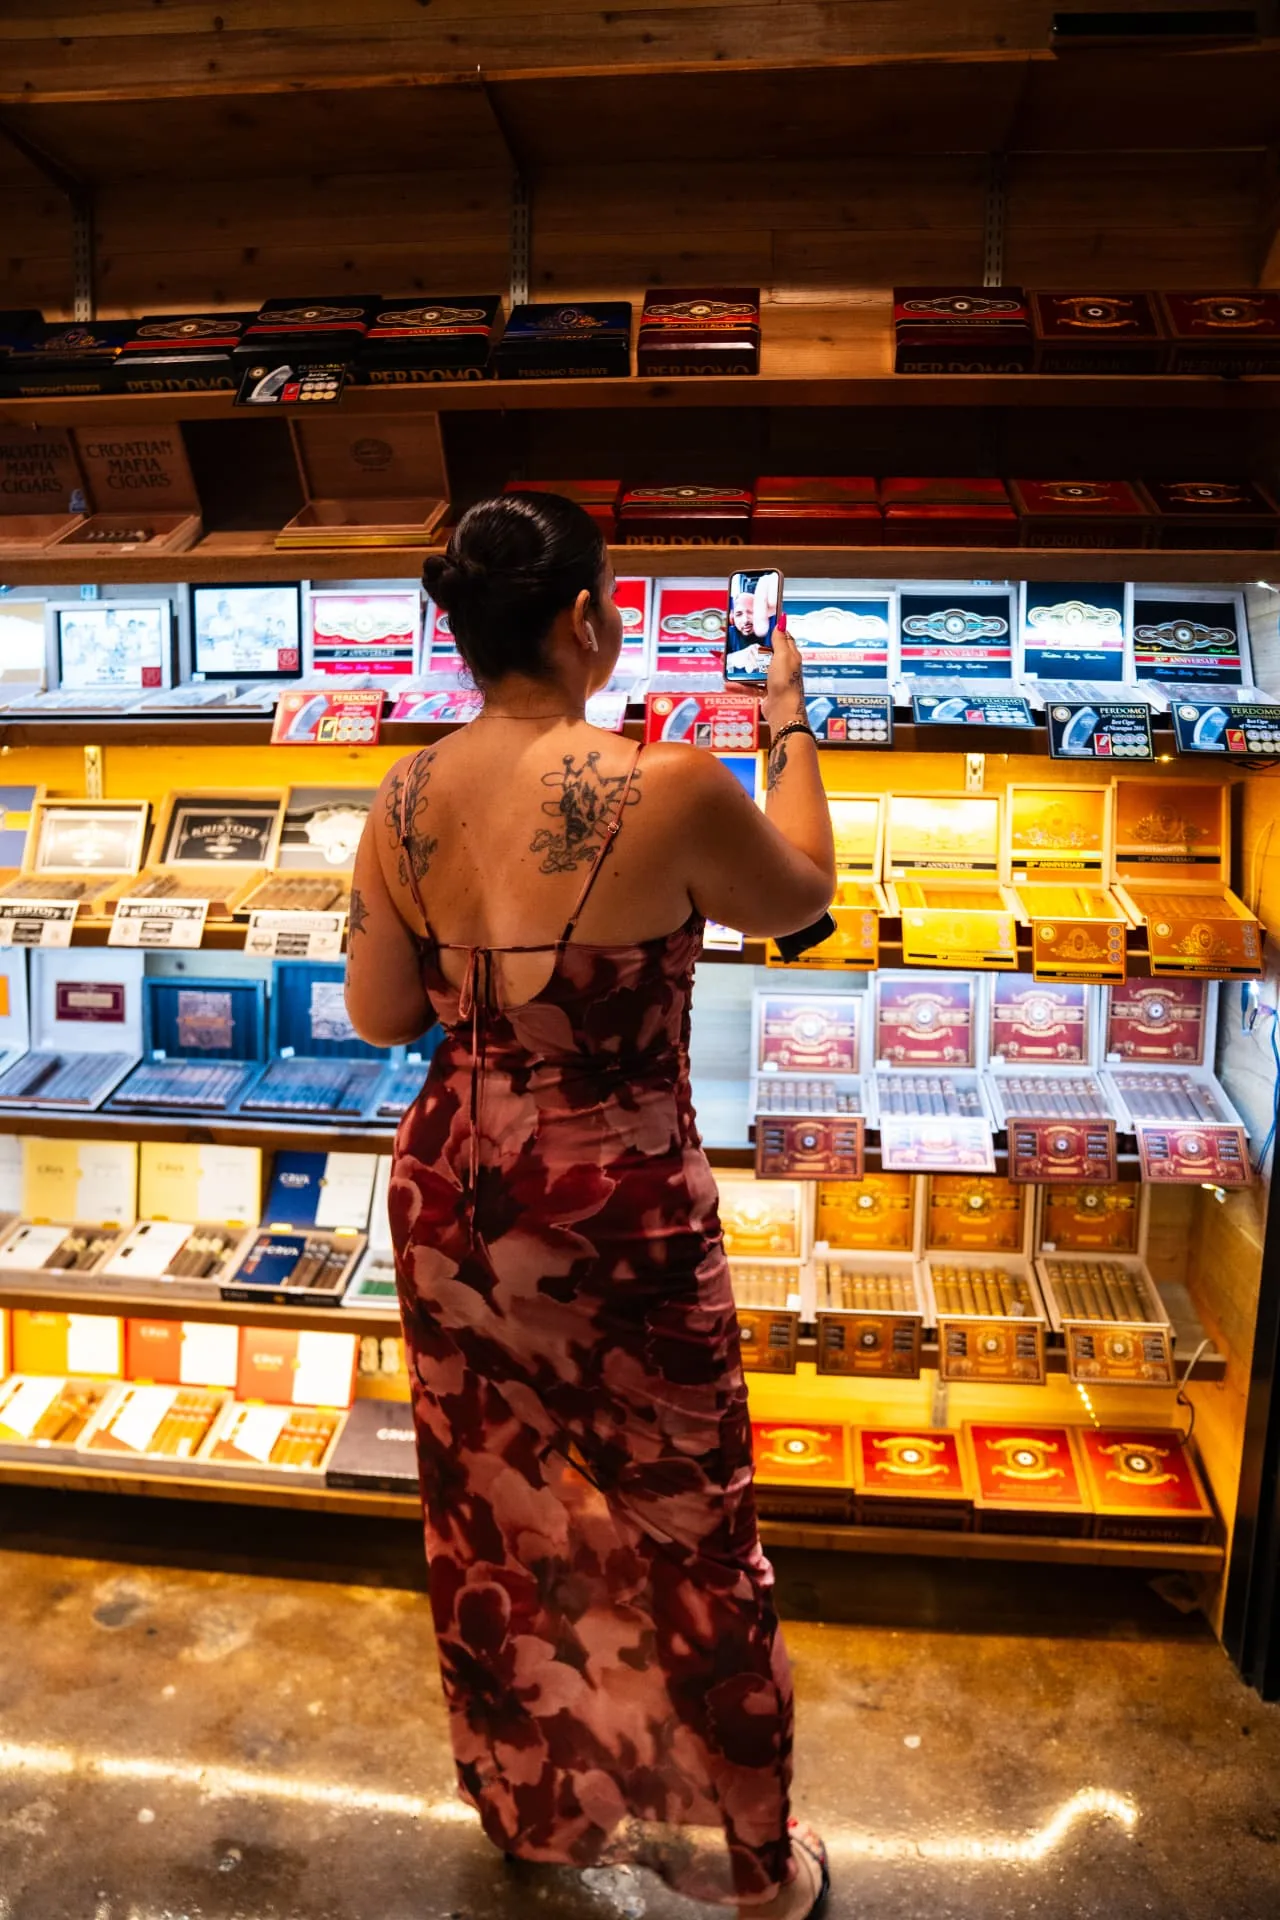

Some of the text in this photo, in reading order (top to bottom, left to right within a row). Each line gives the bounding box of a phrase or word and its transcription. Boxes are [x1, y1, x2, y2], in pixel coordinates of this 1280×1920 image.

[369, 367, 483, 382] PERDOMO
[0, 443, 69, 460] ROATIAN
[85, 441, 174, 458] CROATIAN
[6, 461, 56, 476] MAFIA
[108, 458, 162, 473] MAFIA
[1, 478, 63, 494] CIGARS
[106, 473, 172, 489] CIGARS
[1169, 656, 1220, 666] ANNIVERSARY
[704, 697, 754, 705] PERDOMO
[837, 696, 887, 705] PERDOMO
[1100, 706, 1146, 714] PERDOMO
[1231, 706, 1280, 716] PERDOMO
[191, 822, 260, 838] KRISTOFF
[1039, 861, 1085, 869] ANNIVERSARY
[1150, 856, 1196, 864] ANNIVERSARY
